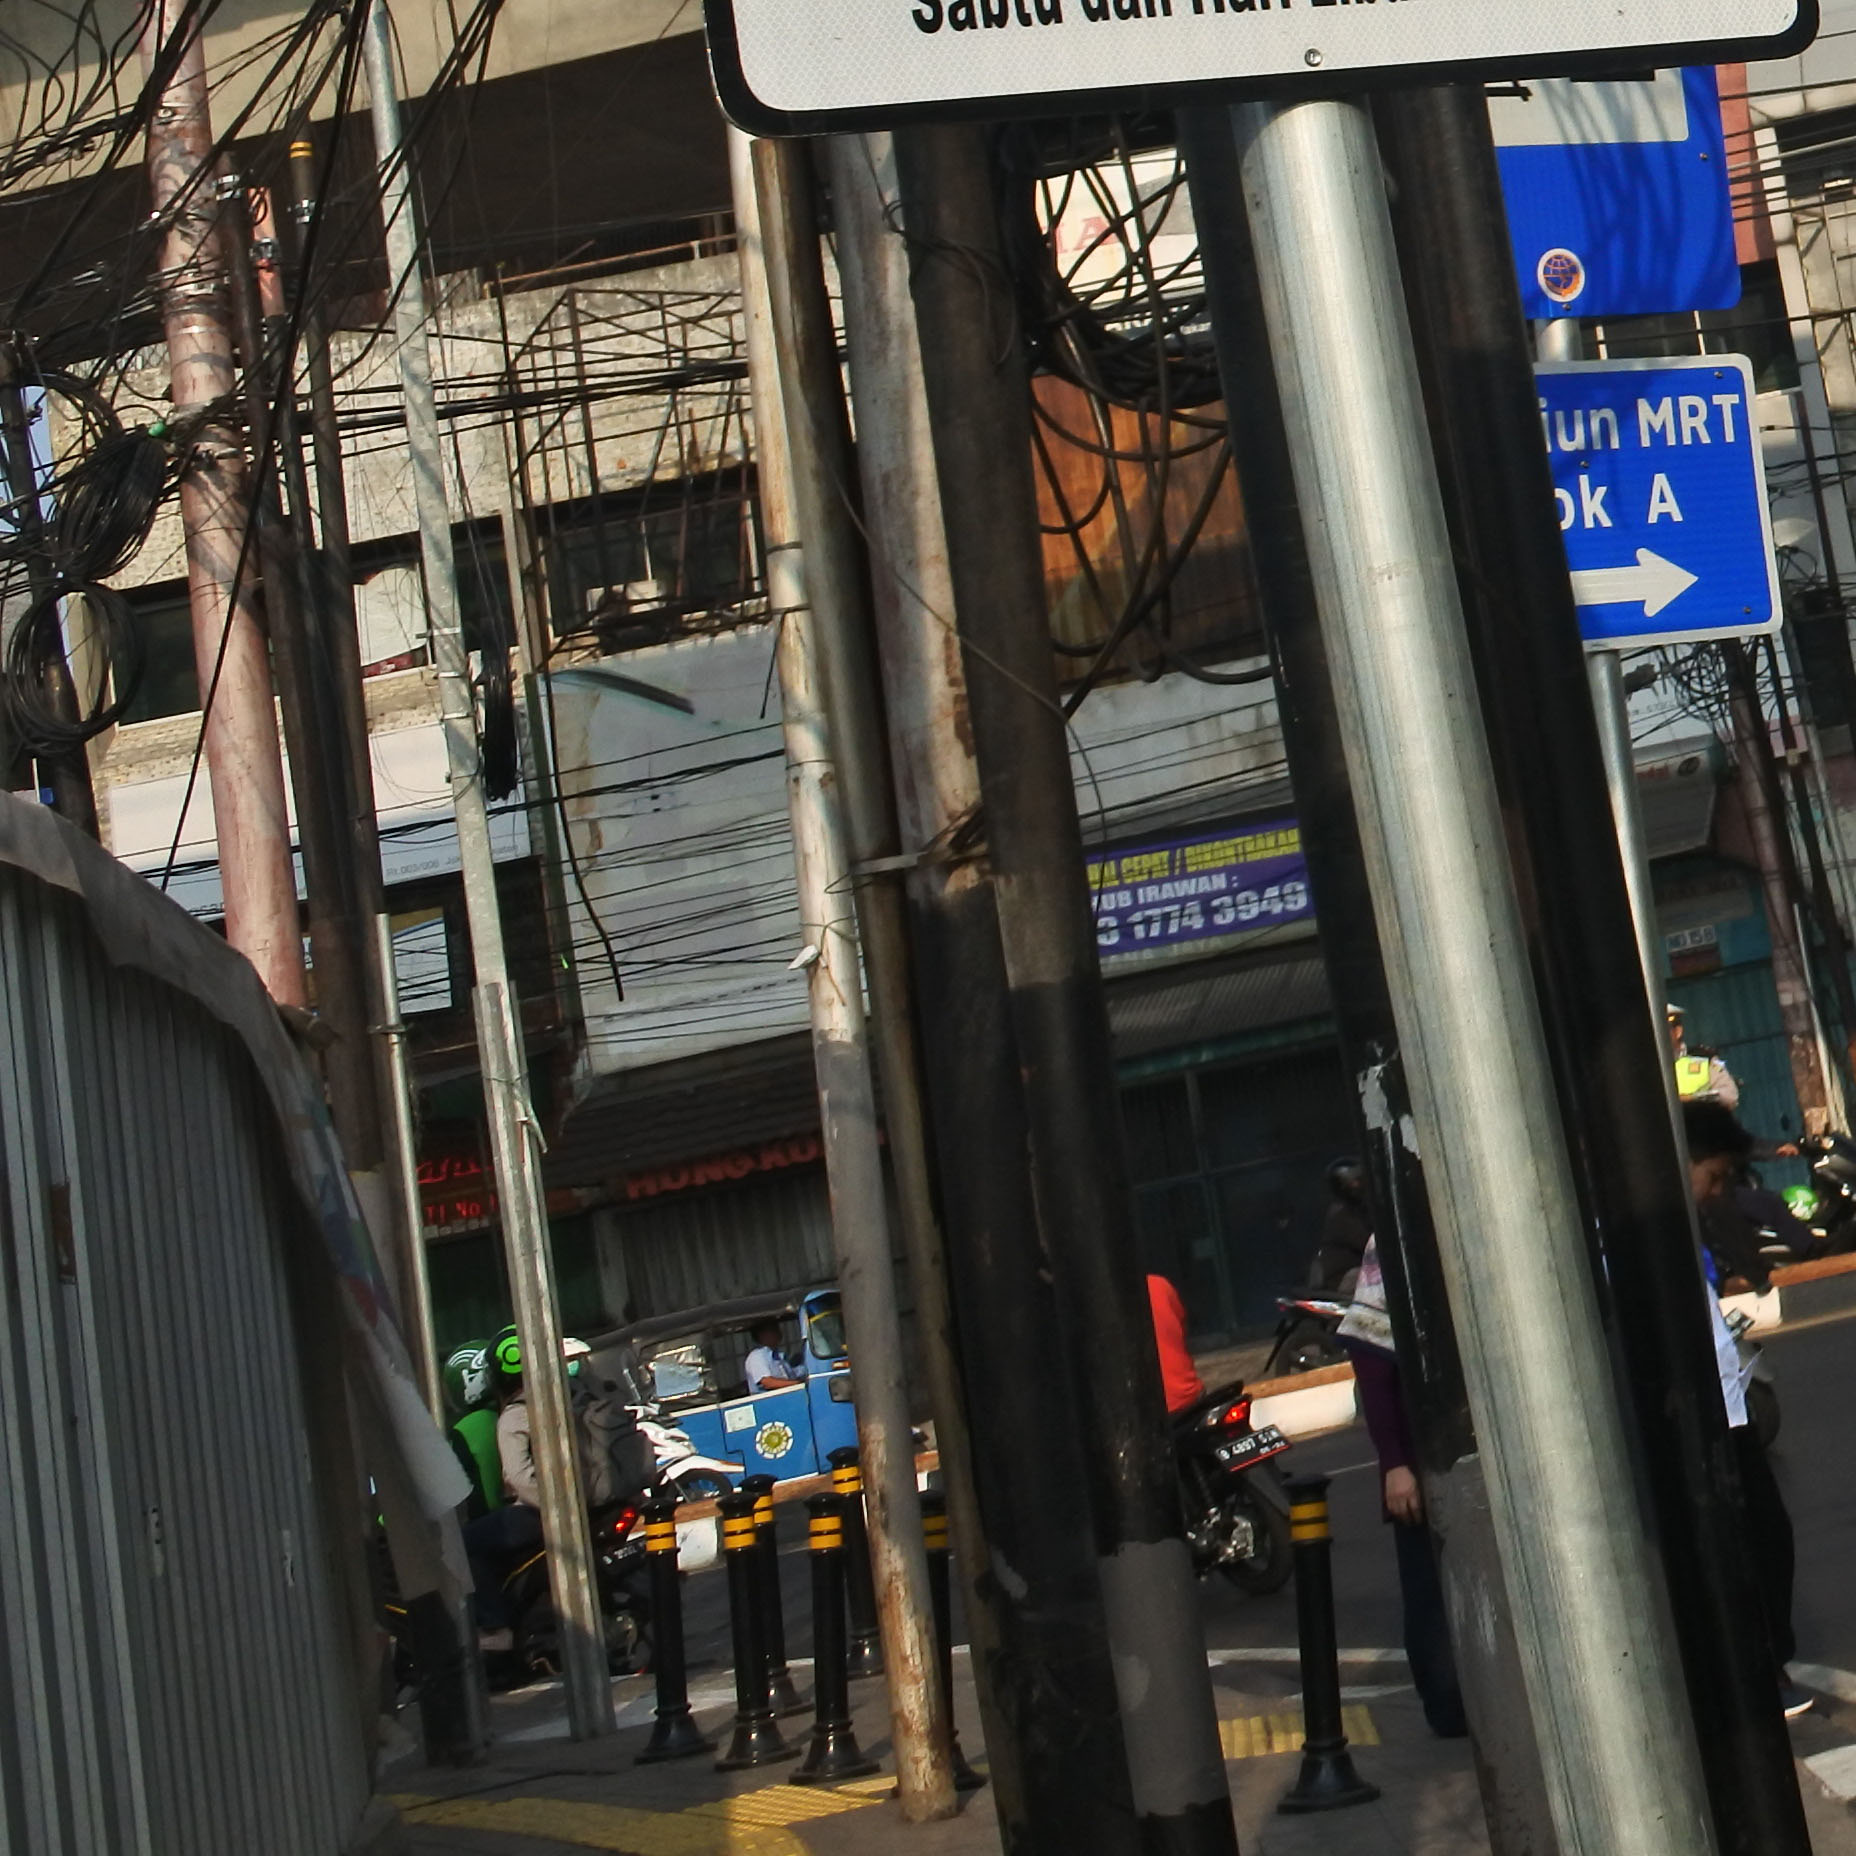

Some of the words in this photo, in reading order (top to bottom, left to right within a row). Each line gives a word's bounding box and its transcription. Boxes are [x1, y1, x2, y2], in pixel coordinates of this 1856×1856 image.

[1637, 394, 1740, 448] MRT
[1648, 473, 1684, 524] A
[1125, 900, 1205, 941] 1774
[1210, 880, 1309, 925] 3949
[1137, 872, 1228, 905] IRAWAN
